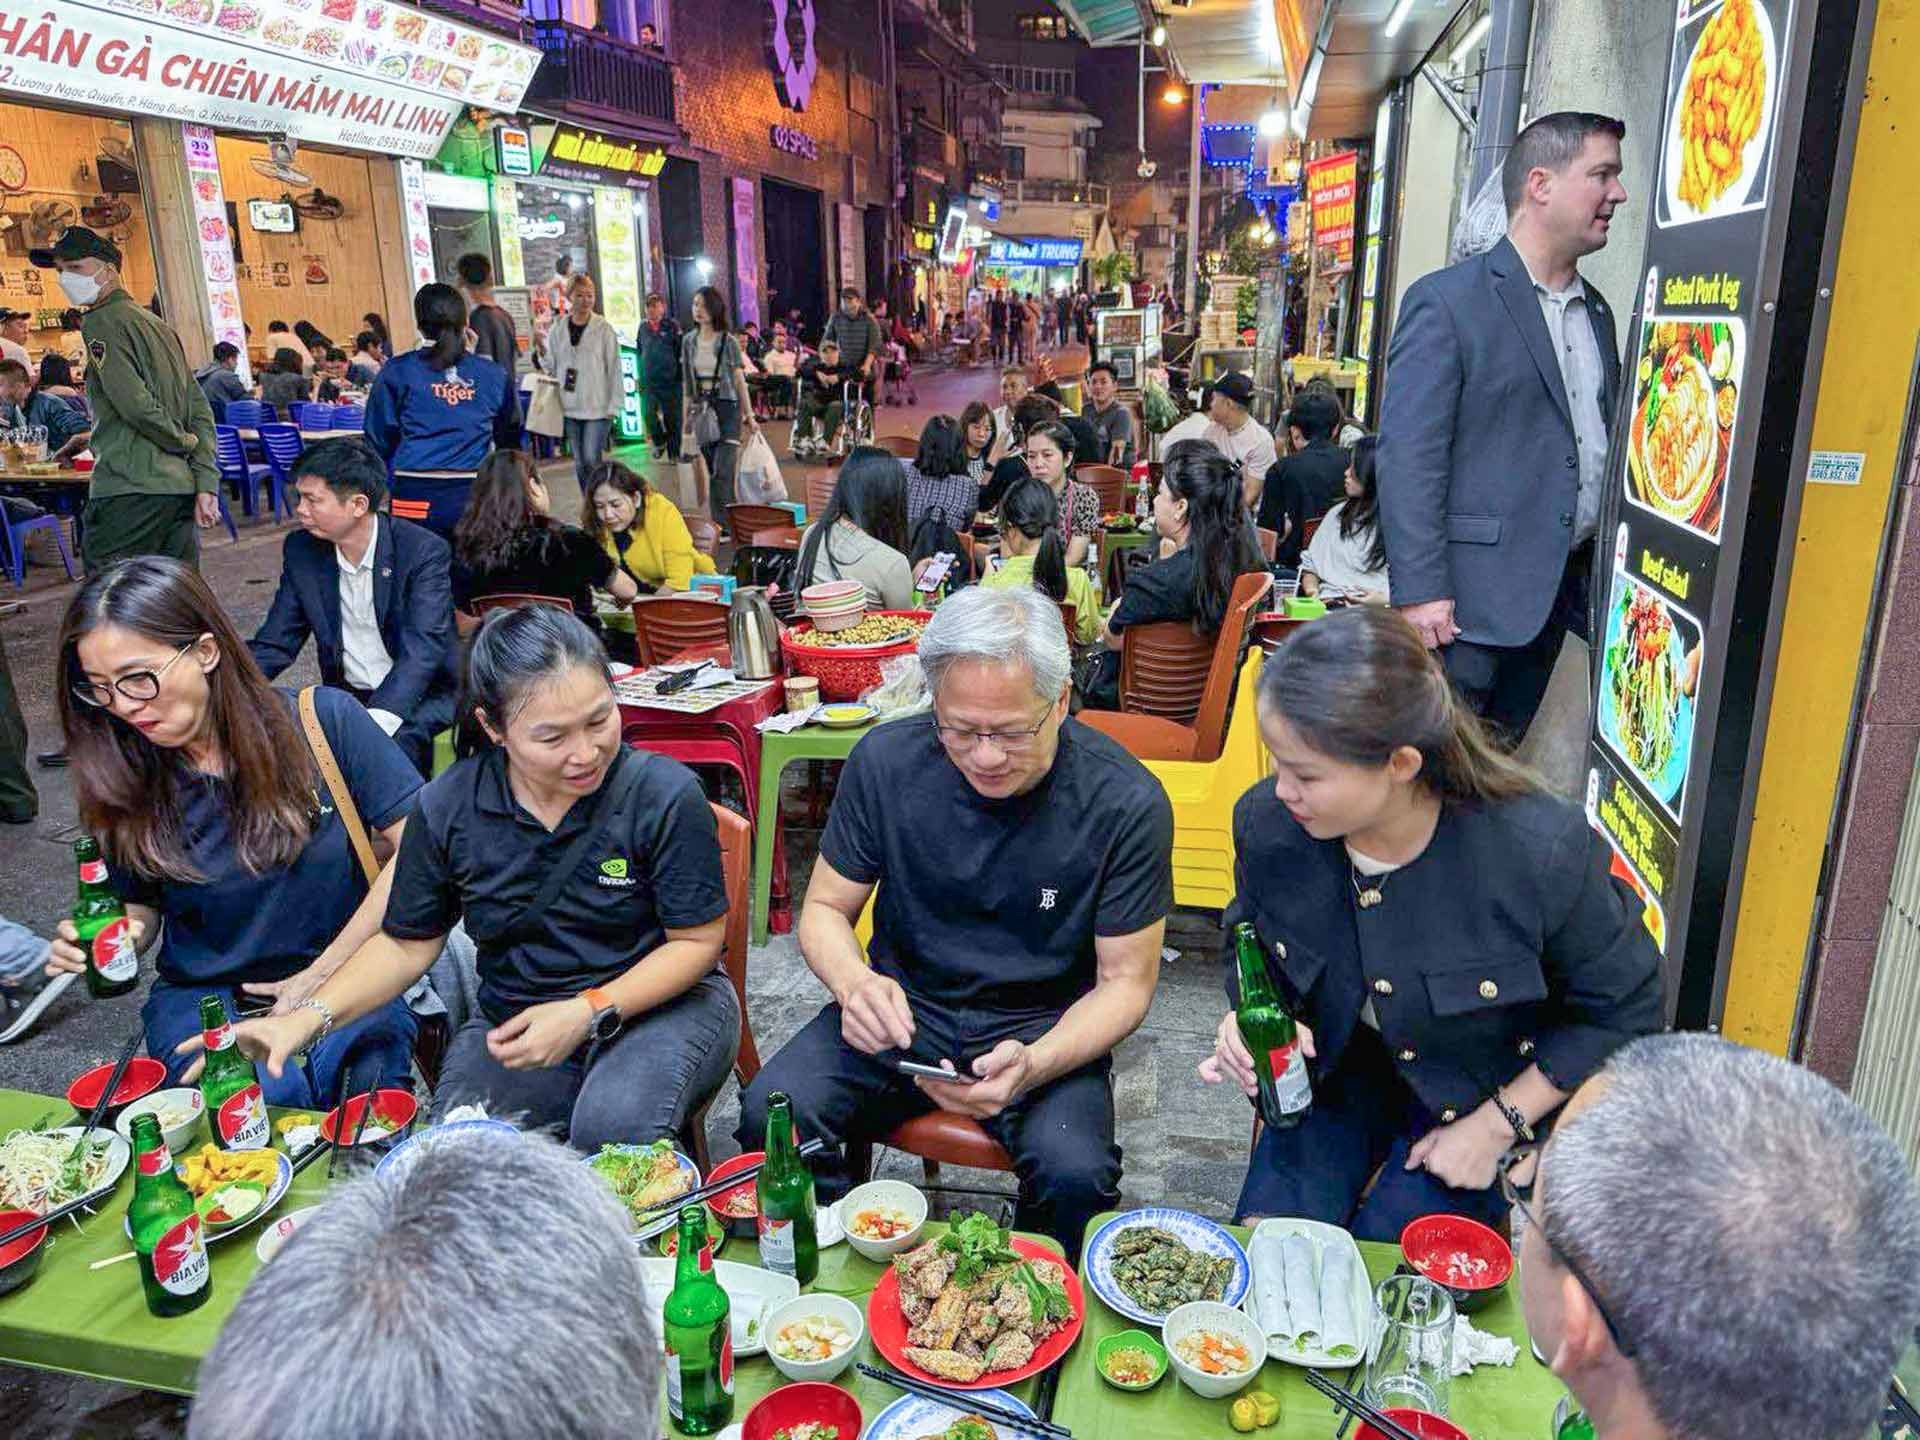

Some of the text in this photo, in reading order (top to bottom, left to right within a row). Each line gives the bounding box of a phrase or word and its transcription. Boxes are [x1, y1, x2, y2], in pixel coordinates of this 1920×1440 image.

[96, 35, 152, 81] GÀ
[161, 54, 269, 103] CHIÊN
[267, 74, 344, 117] MẮM
[341, 92, 395, 126] MAI
[393, 103, 451, 137] LINH
[338, 127, 377, 146] Hotline:
[1663, 271, 1740, 311] Salted Pork leg
[431, 383, 476, 406] Tiger
[1661, 565, 1689, 600] salad
[1614, 780, 1654, 850] Fried egg
[1618, 818, 1637, 863] Pork
[1638, 843, 1663, 896] brain
[234, 1129, 253, 1143] BIA
[170, 1266, 192, 1284] BIA
